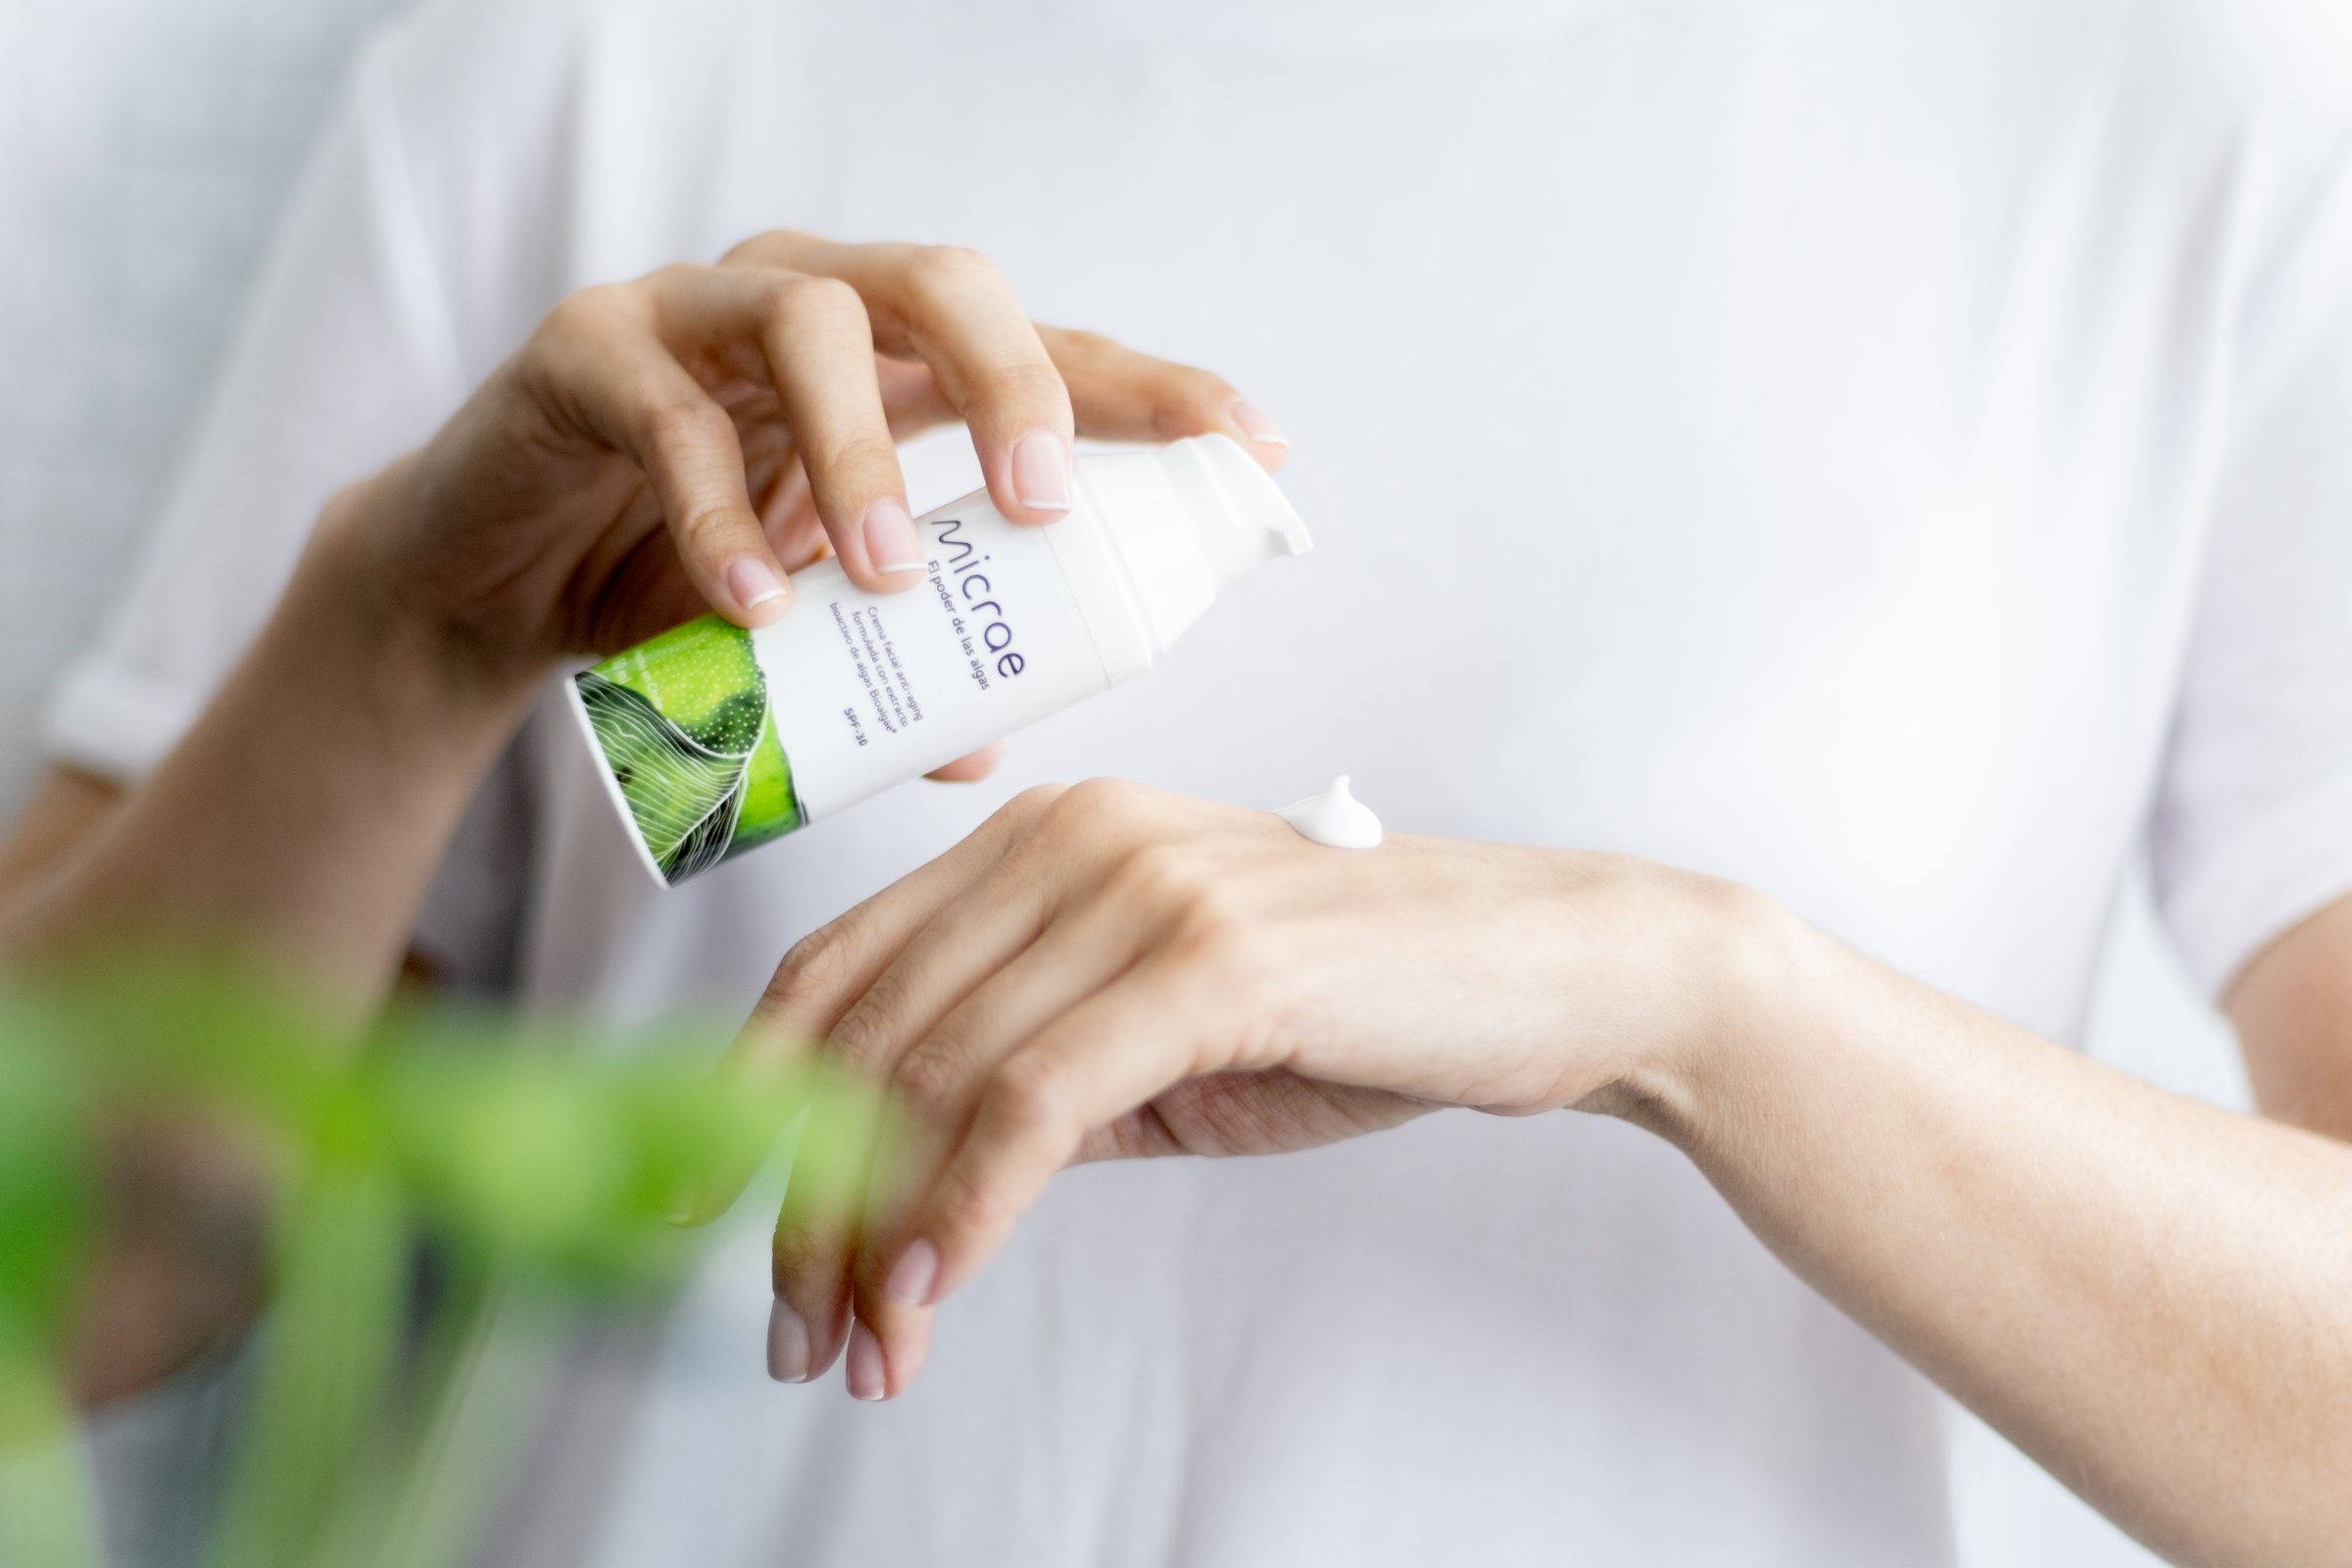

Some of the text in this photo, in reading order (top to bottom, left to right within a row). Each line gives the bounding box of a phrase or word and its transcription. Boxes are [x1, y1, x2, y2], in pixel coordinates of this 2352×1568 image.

[830, 601, 854, 645] bioactivo
[850, 646, 860, 661] de
[857, 662, 873, 689] algas
[852, 611, 908, 728] formulada con extracto
[867, 606, 923, 722] Crema facial anti-aging
[929, 575, 956, 613] poder
[952, 617, 965, 635] de
[960, 636, 975, 657] las
[970, 659, 991, 690] algas
[844, 707, 868, 747] SPF-30
